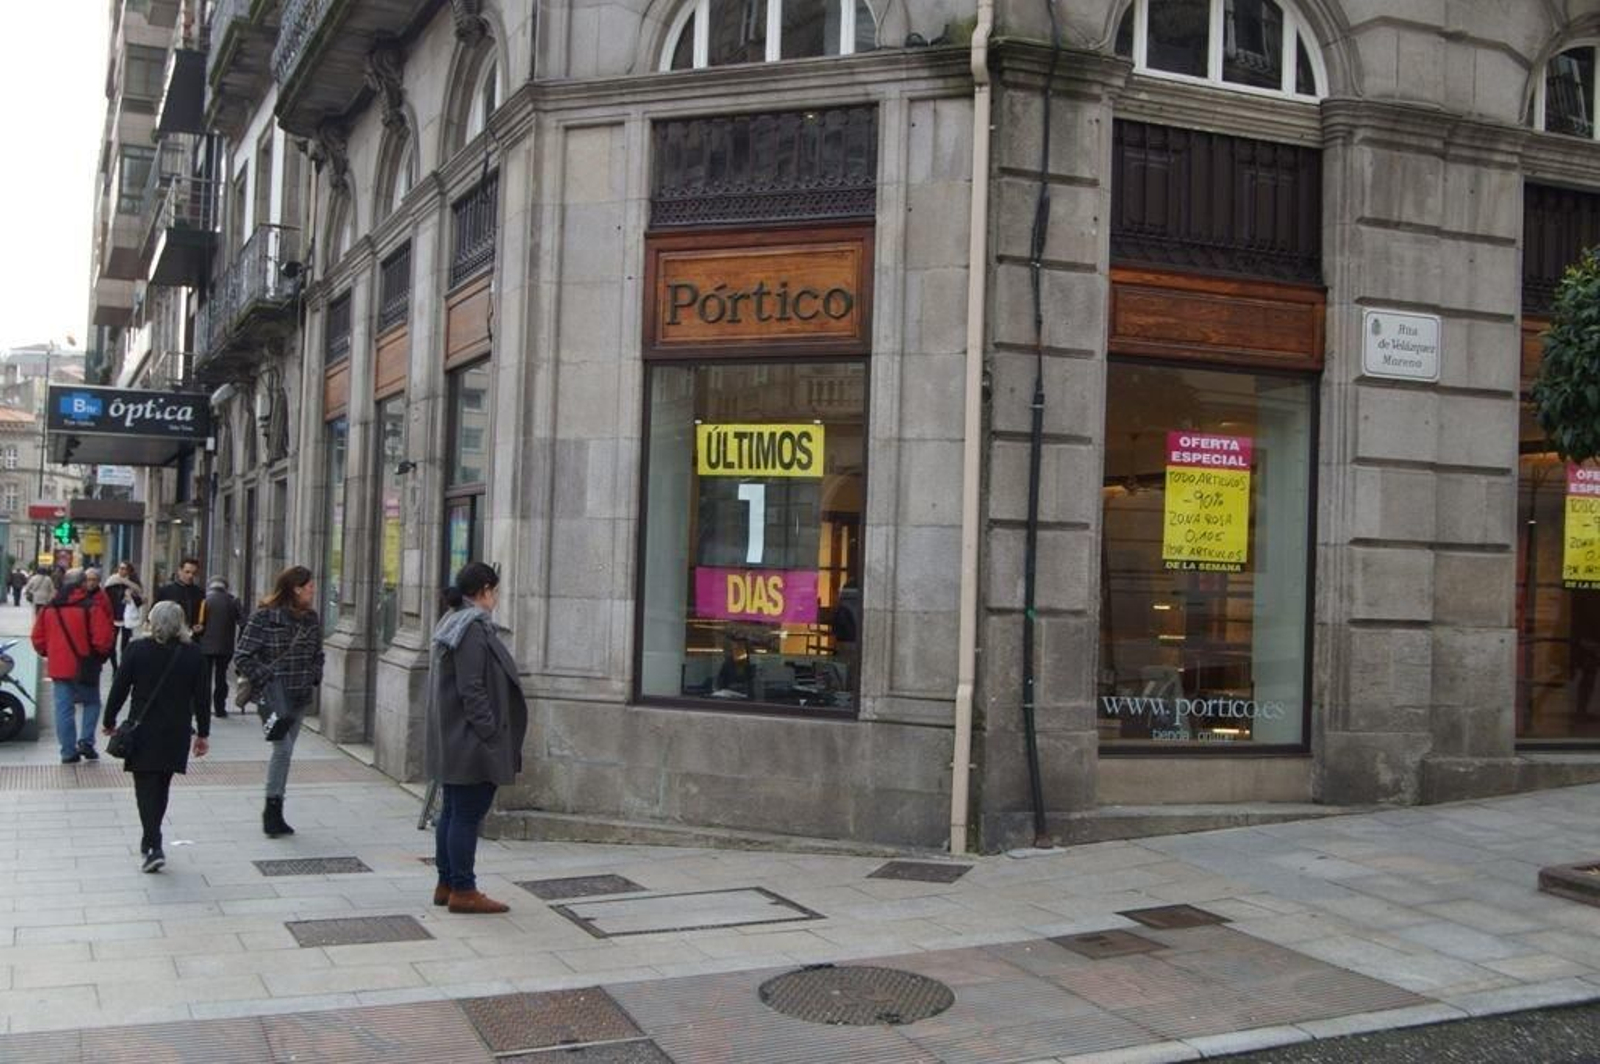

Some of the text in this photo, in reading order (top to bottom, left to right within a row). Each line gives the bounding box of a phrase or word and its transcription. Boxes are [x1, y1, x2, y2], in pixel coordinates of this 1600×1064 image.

[666, 281, 854, 326] Pórtico
[1377, 339, 1391, 350] de
[1382, 354, 1422, 368] Moreno
[706, 426, 813, 471] ÚLTIMOS
[1179, 436, 1240, 451] OFERTA
[1171, 450, 1248, 466] ESPECIAL
[738, 483, 765, 564] 1
[1164, 561, 1242, 573] DE LA SEMANA
[727, 573, 784, 616] DÍAS
[1102, 696, 1287, 726] www.portico.es
